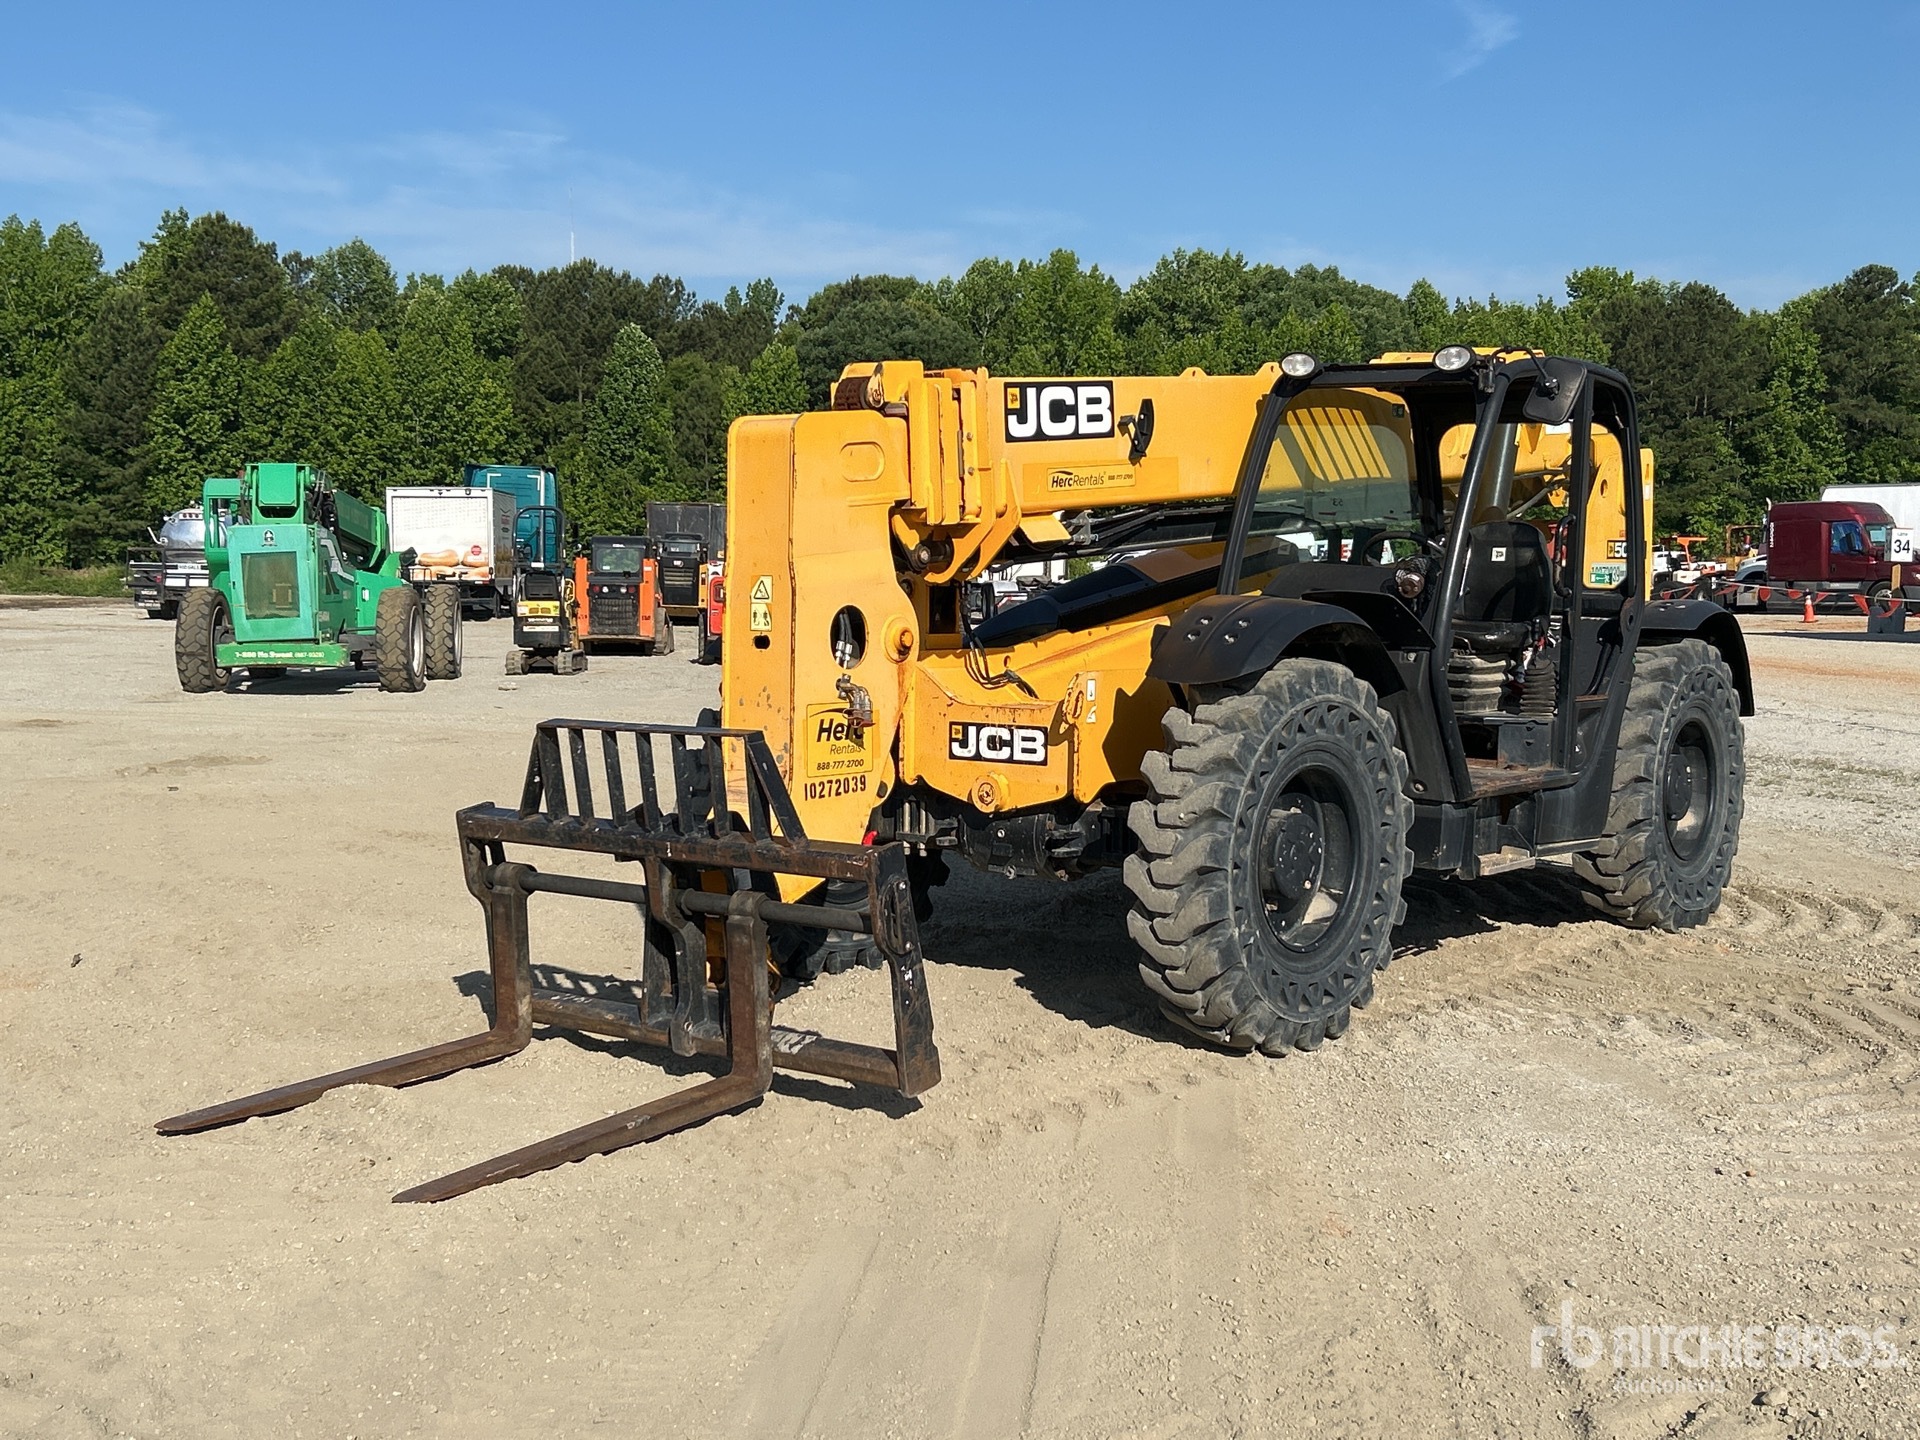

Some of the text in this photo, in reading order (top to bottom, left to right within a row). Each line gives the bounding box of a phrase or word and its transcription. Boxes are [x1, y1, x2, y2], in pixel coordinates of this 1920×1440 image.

[1007, 386, 1112, 438] JCB
[1894, 539, 1910, 554] 34
[951, 725, 1045, 762] JCB
[804, 774, 867, 801] 10272039
